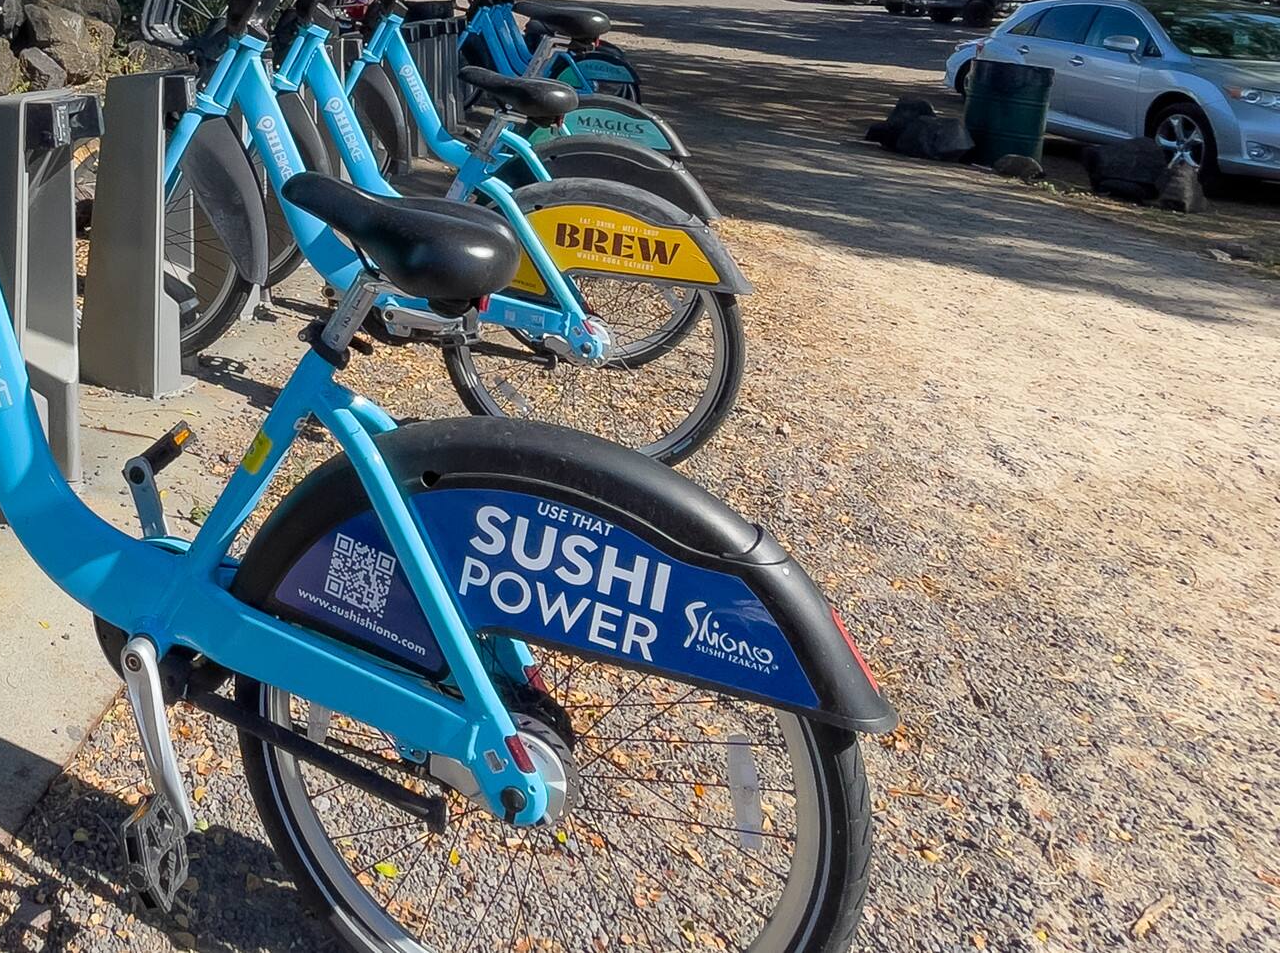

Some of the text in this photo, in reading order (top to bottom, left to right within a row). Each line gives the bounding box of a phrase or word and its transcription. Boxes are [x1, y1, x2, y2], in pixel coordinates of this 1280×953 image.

[333, 110, 366, 163] HIBIKE
[577, 115, 645, 134] MAGICS
[555, 222, 681, 265] BREW
[536, 501, 615, 537] USE THAT
[469, 504, 672, 613] SUSHI
[297, 588, 427, 656] www.sushishiono.com
[458, 556, 659, 663] POWER
[695, 643, 771, 675] SUSHI IZAKAYA
